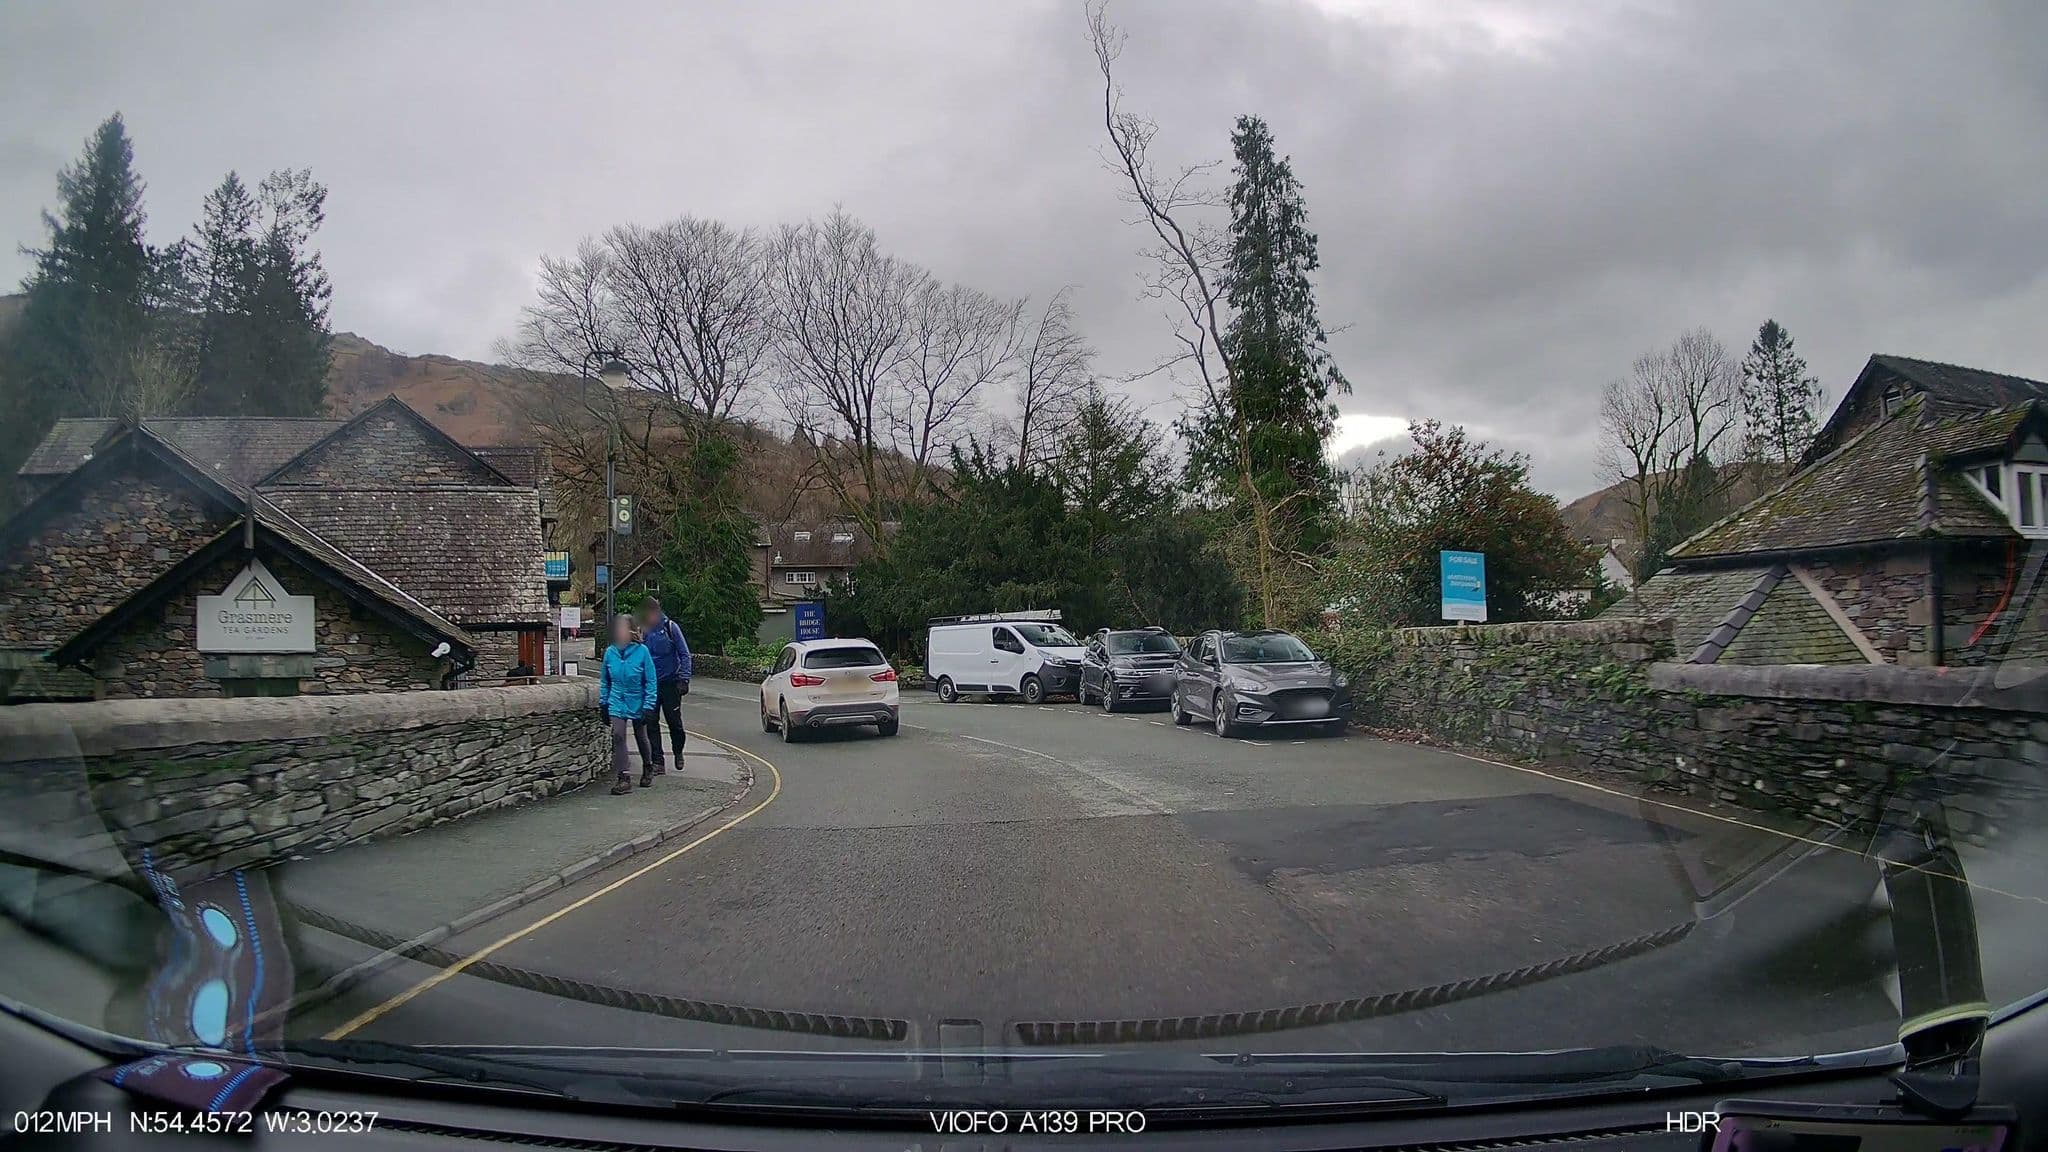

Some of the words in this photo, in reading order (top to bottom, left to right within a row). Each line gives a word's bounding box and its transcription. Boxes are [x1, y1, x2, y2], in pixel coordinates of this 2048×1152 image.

[1448, 555, 1463, 564] FOR
[217, 610, 293, 624] Grasmere
[804, 610, 816, 618] THE
[223, 626, 239, 634] TEA
[243, 626, 288, 634] GARDENS
[800, 627, 820, 635] HOUSE
